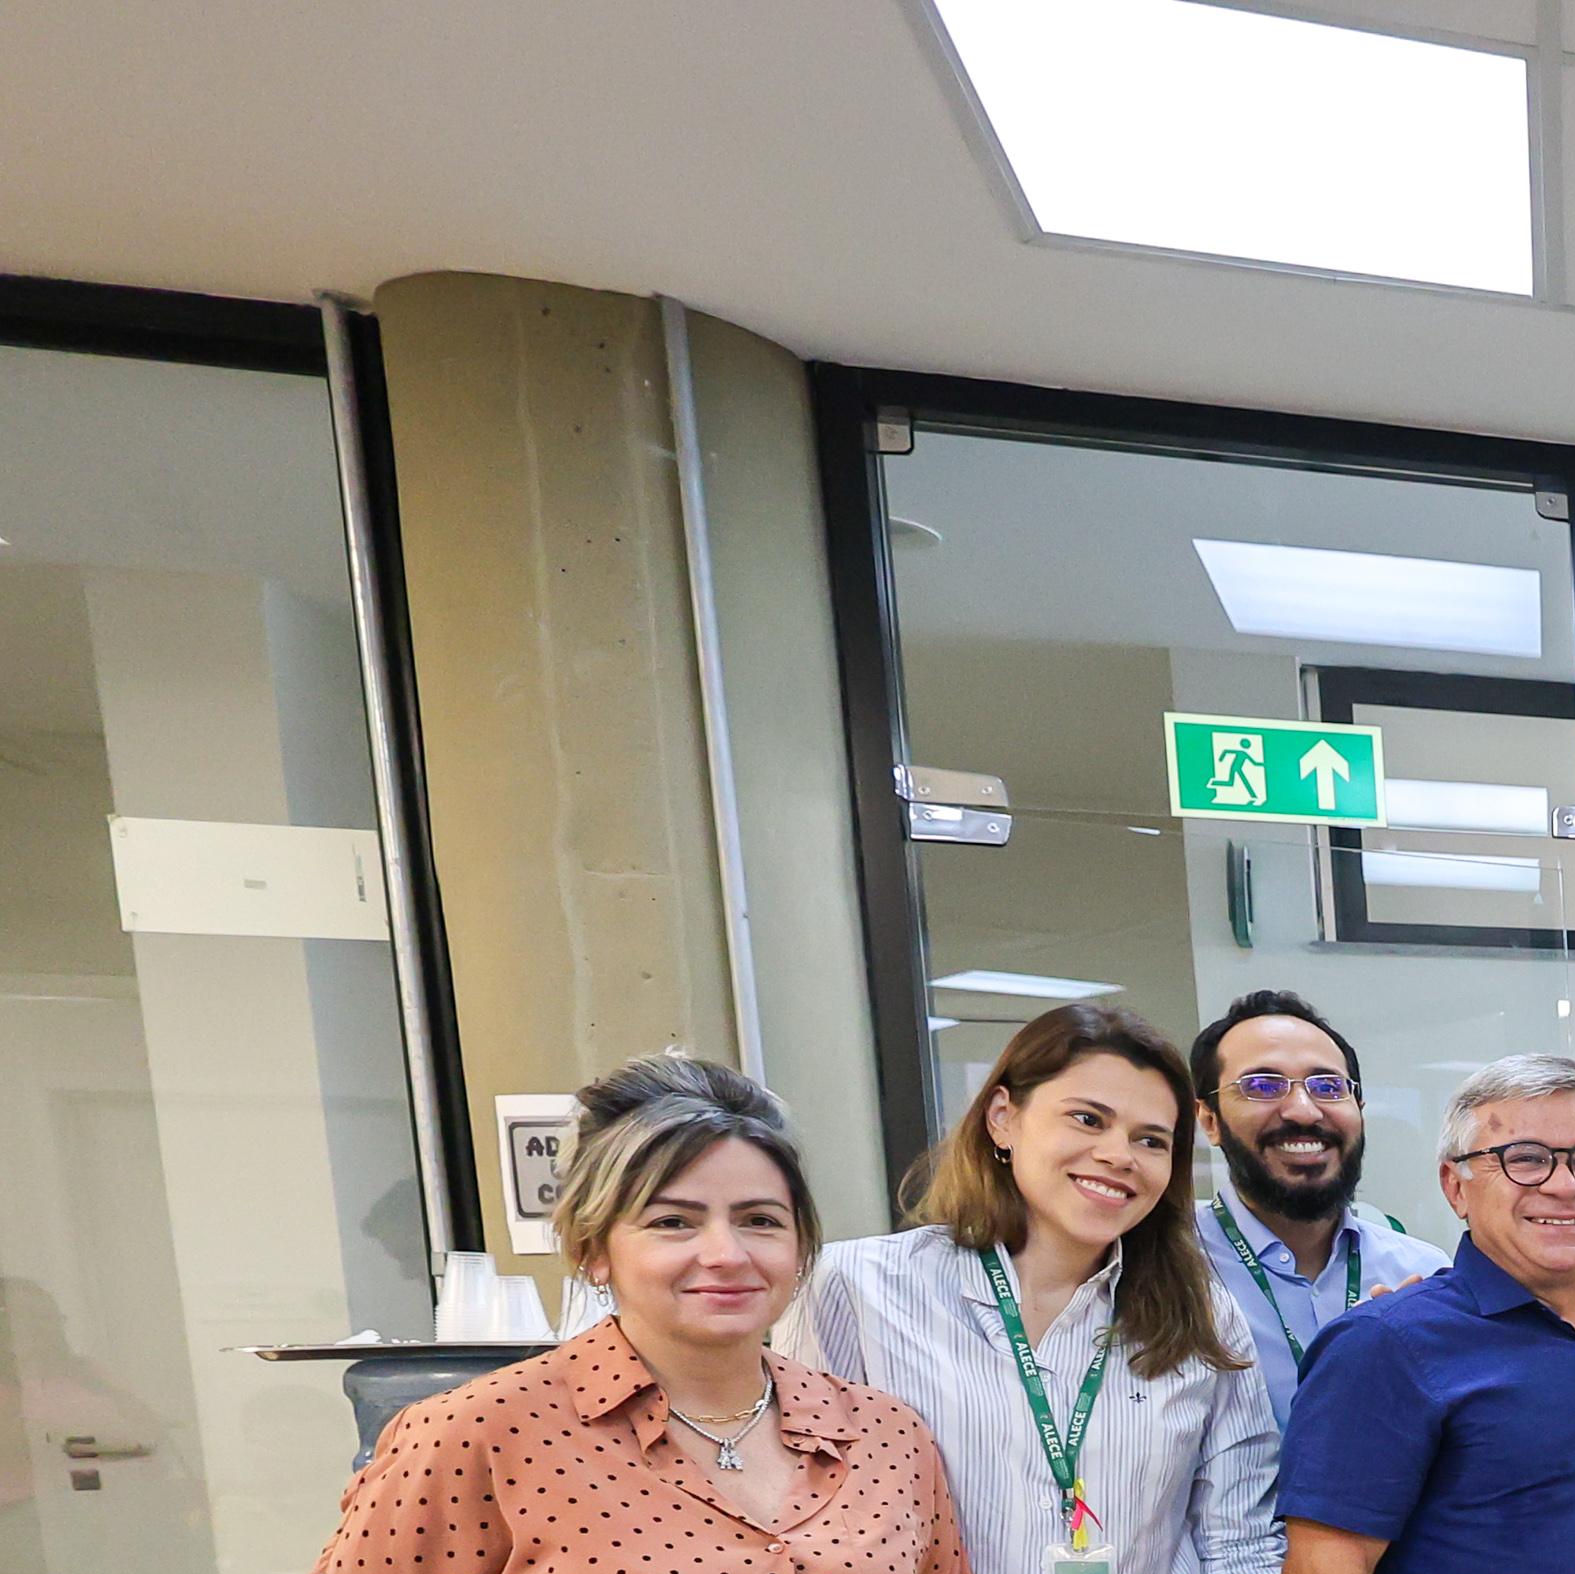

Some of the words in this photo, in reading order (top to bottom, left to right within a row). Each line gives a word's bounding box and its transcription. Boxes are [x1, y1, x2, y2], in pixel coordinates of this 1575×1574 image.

[1234, 1239, 1257, 1267] ALECE
[989, 1268, 1011, 1299] ALECE
[1016, 1341, 1037, 1378] ALECE
[1041, 1422, 1064, 1460] ALECE
[1068, 1411, 1086, 1446] ALECE
